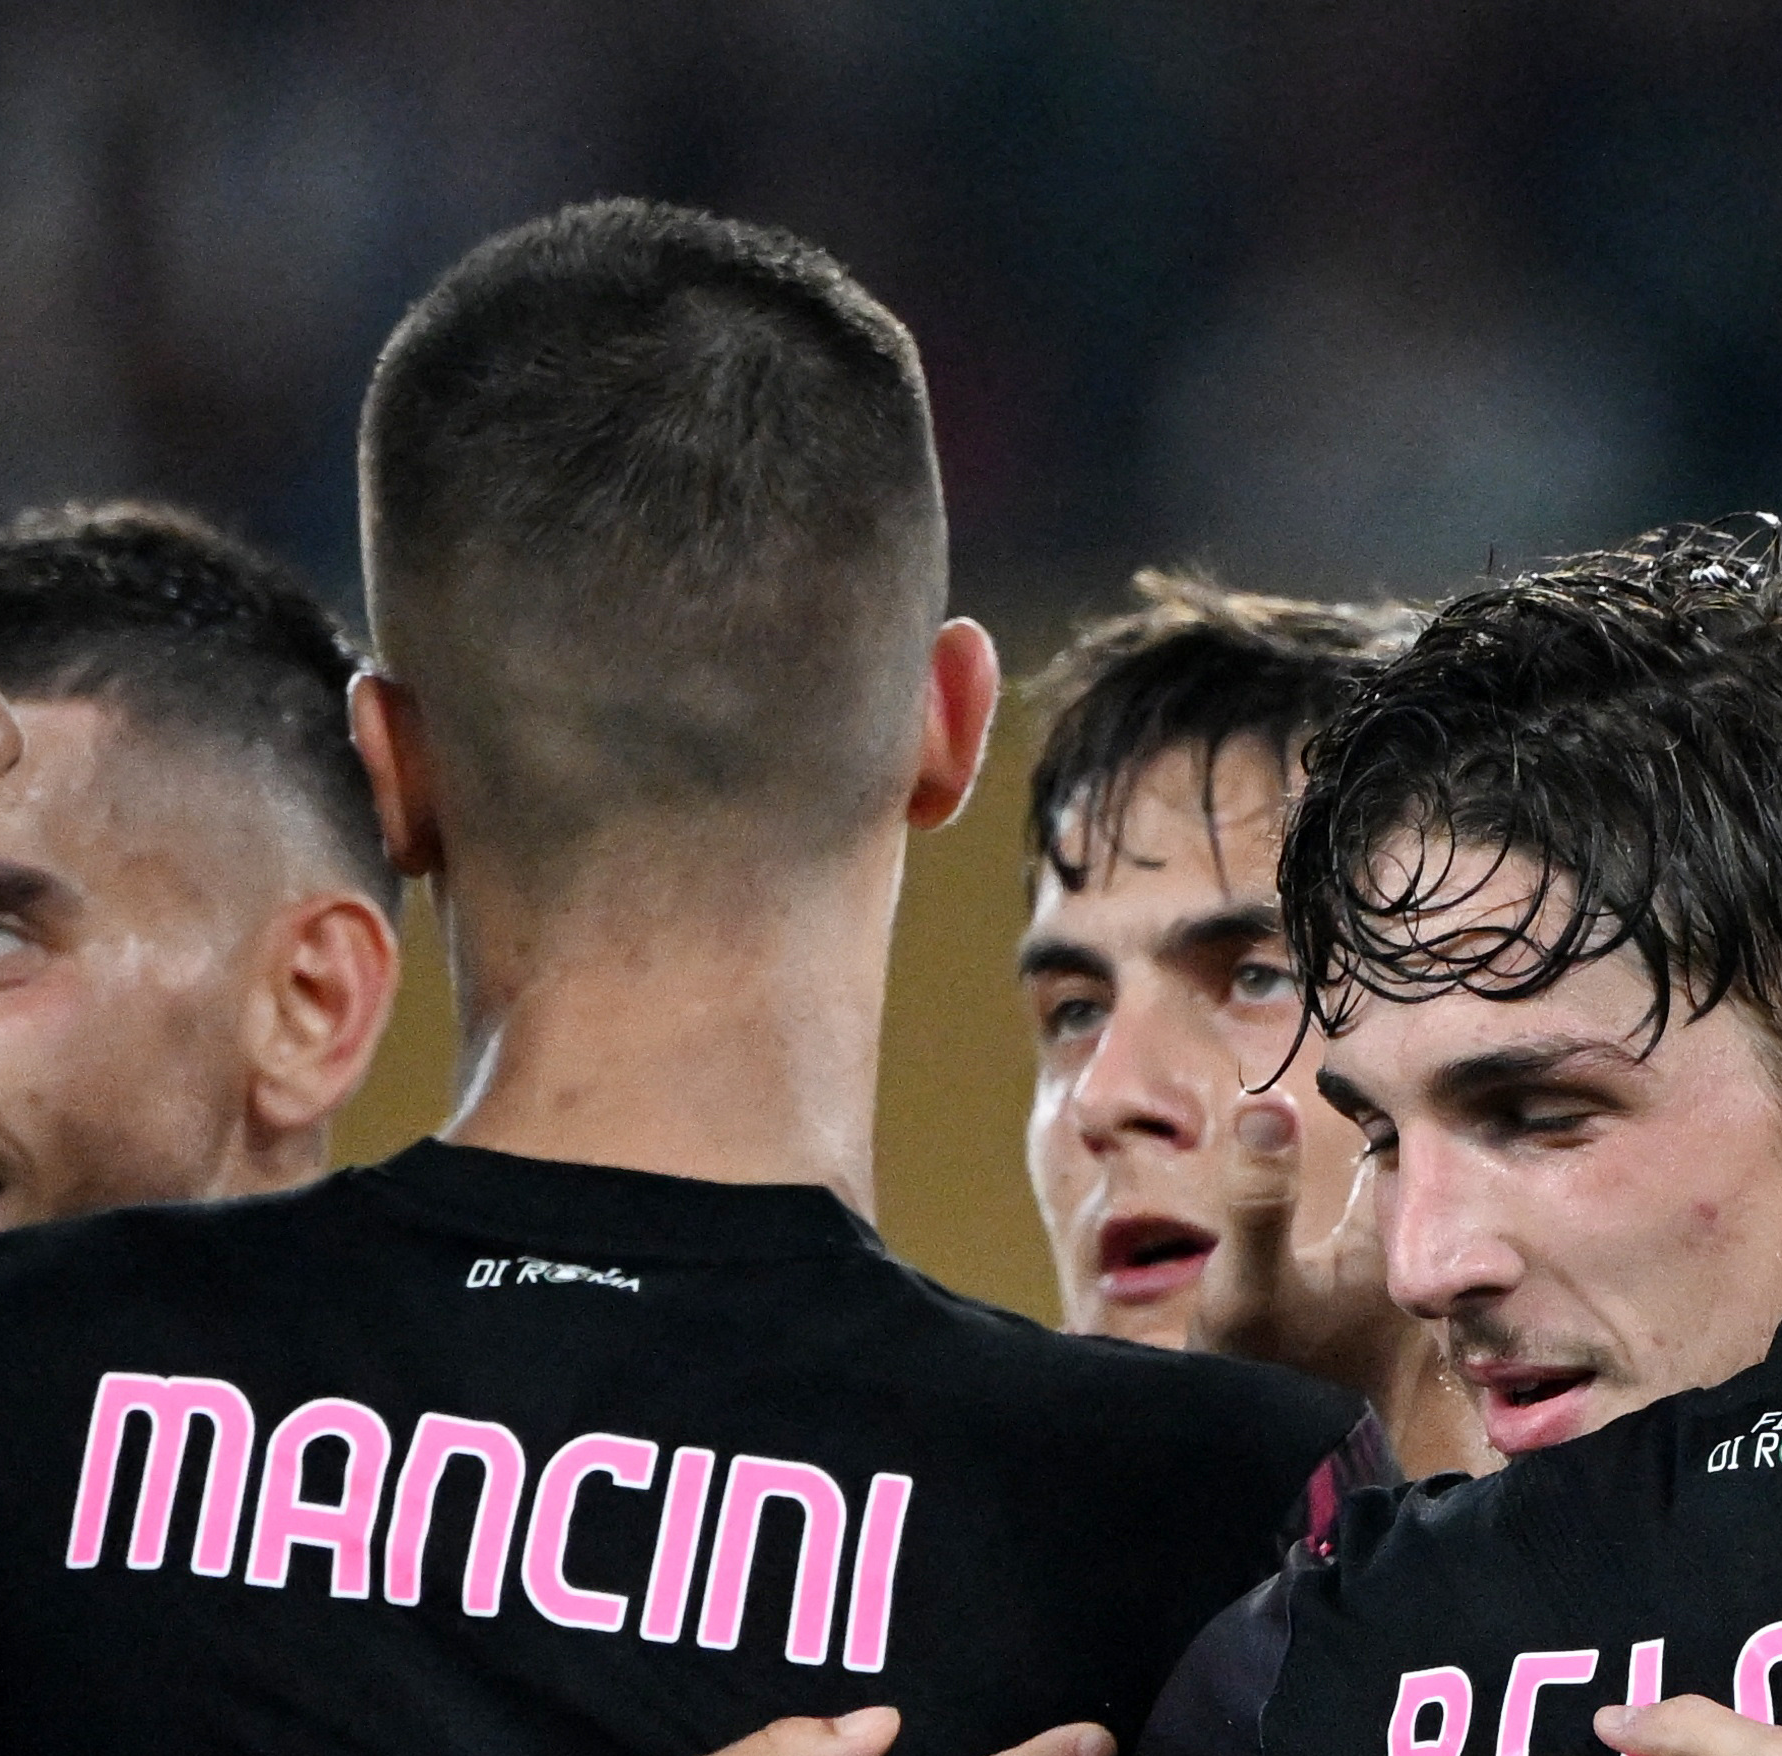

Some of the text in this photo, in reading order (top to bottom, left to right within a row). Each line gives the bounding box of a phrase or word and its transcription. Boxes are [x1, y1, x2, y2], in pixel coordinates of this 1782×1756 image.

[466, 1258, 512, 1289] DI
[1707, 1435, 1745, 1473] DI
[65, 1371, 913, 1673] MANCINI
